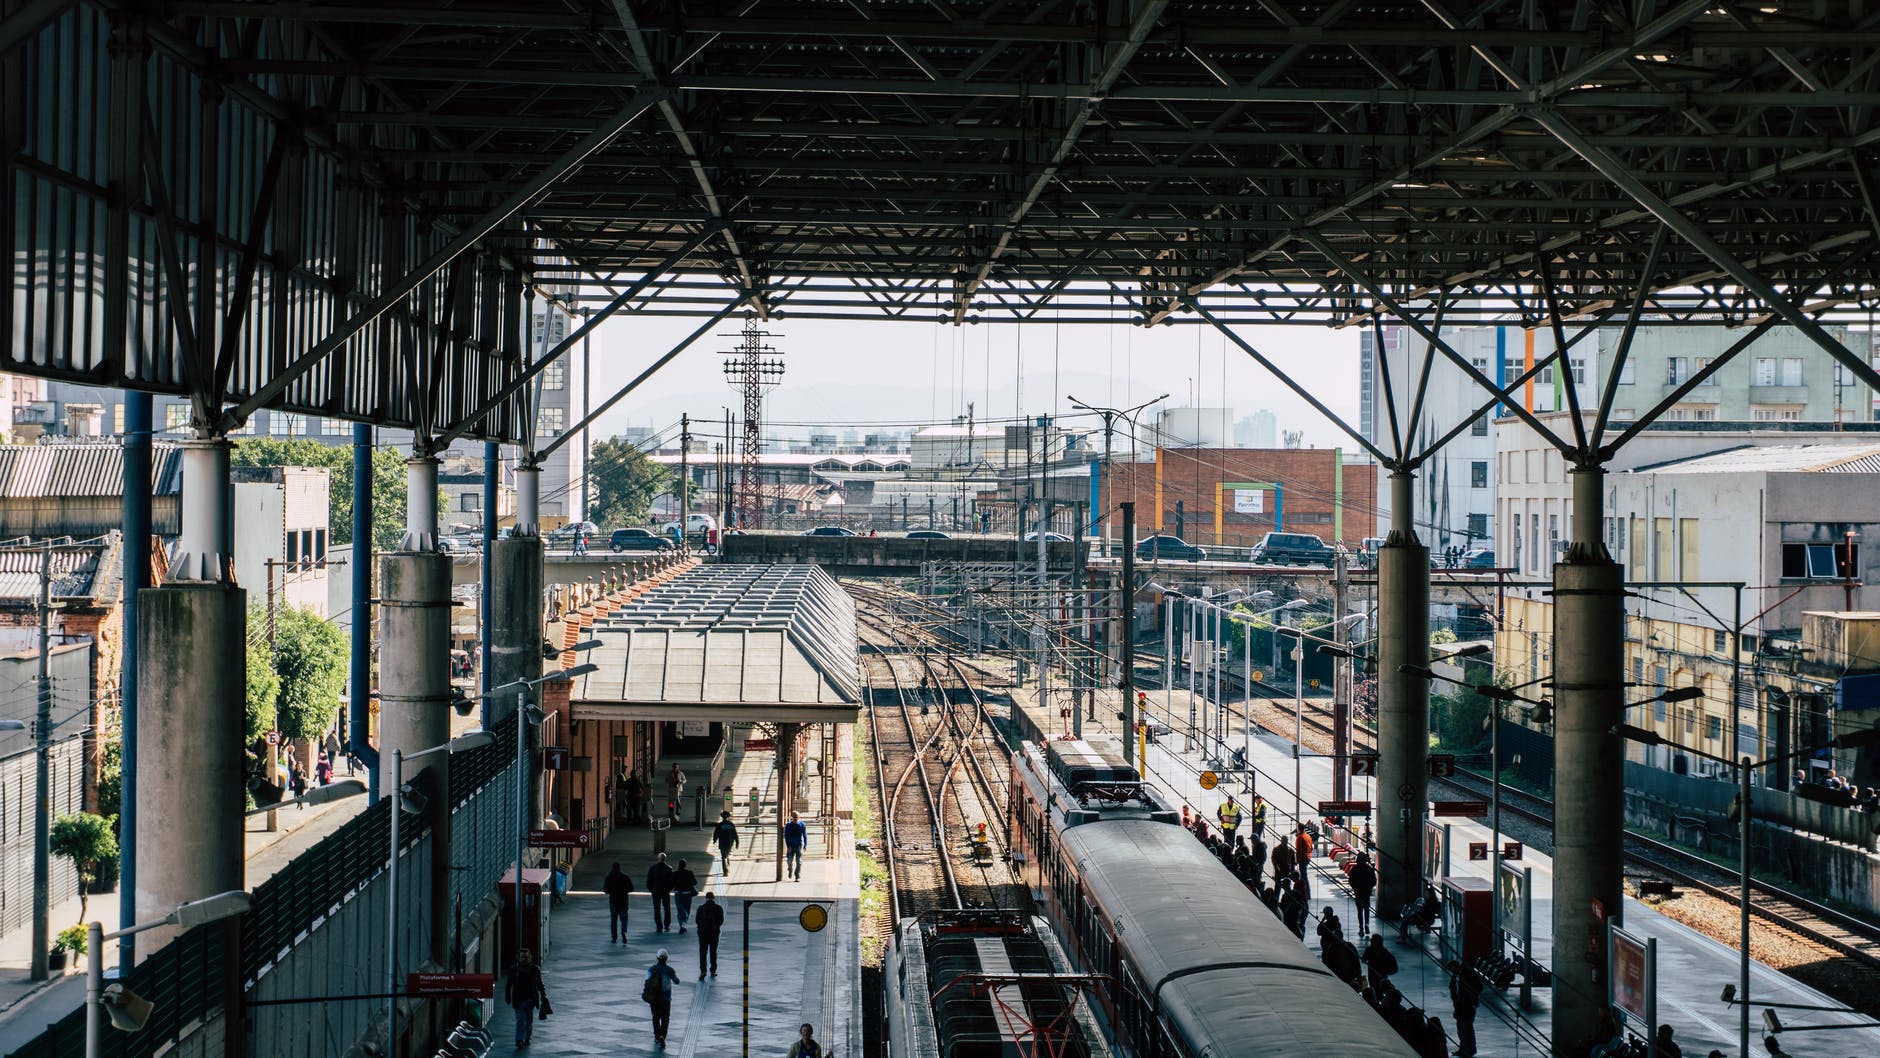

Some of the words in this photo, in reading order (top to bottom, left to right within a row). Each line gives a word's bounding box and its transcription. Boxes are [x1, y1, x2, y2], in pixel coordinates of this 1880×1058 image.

[551, 753, 561, 769] 1
[1356, 760, 1369, 775] 2
[1437, 762, 1447, 776] 3
[1474, 849, 1483, 859] 2
[1510, 849, 1518, 859] 3
